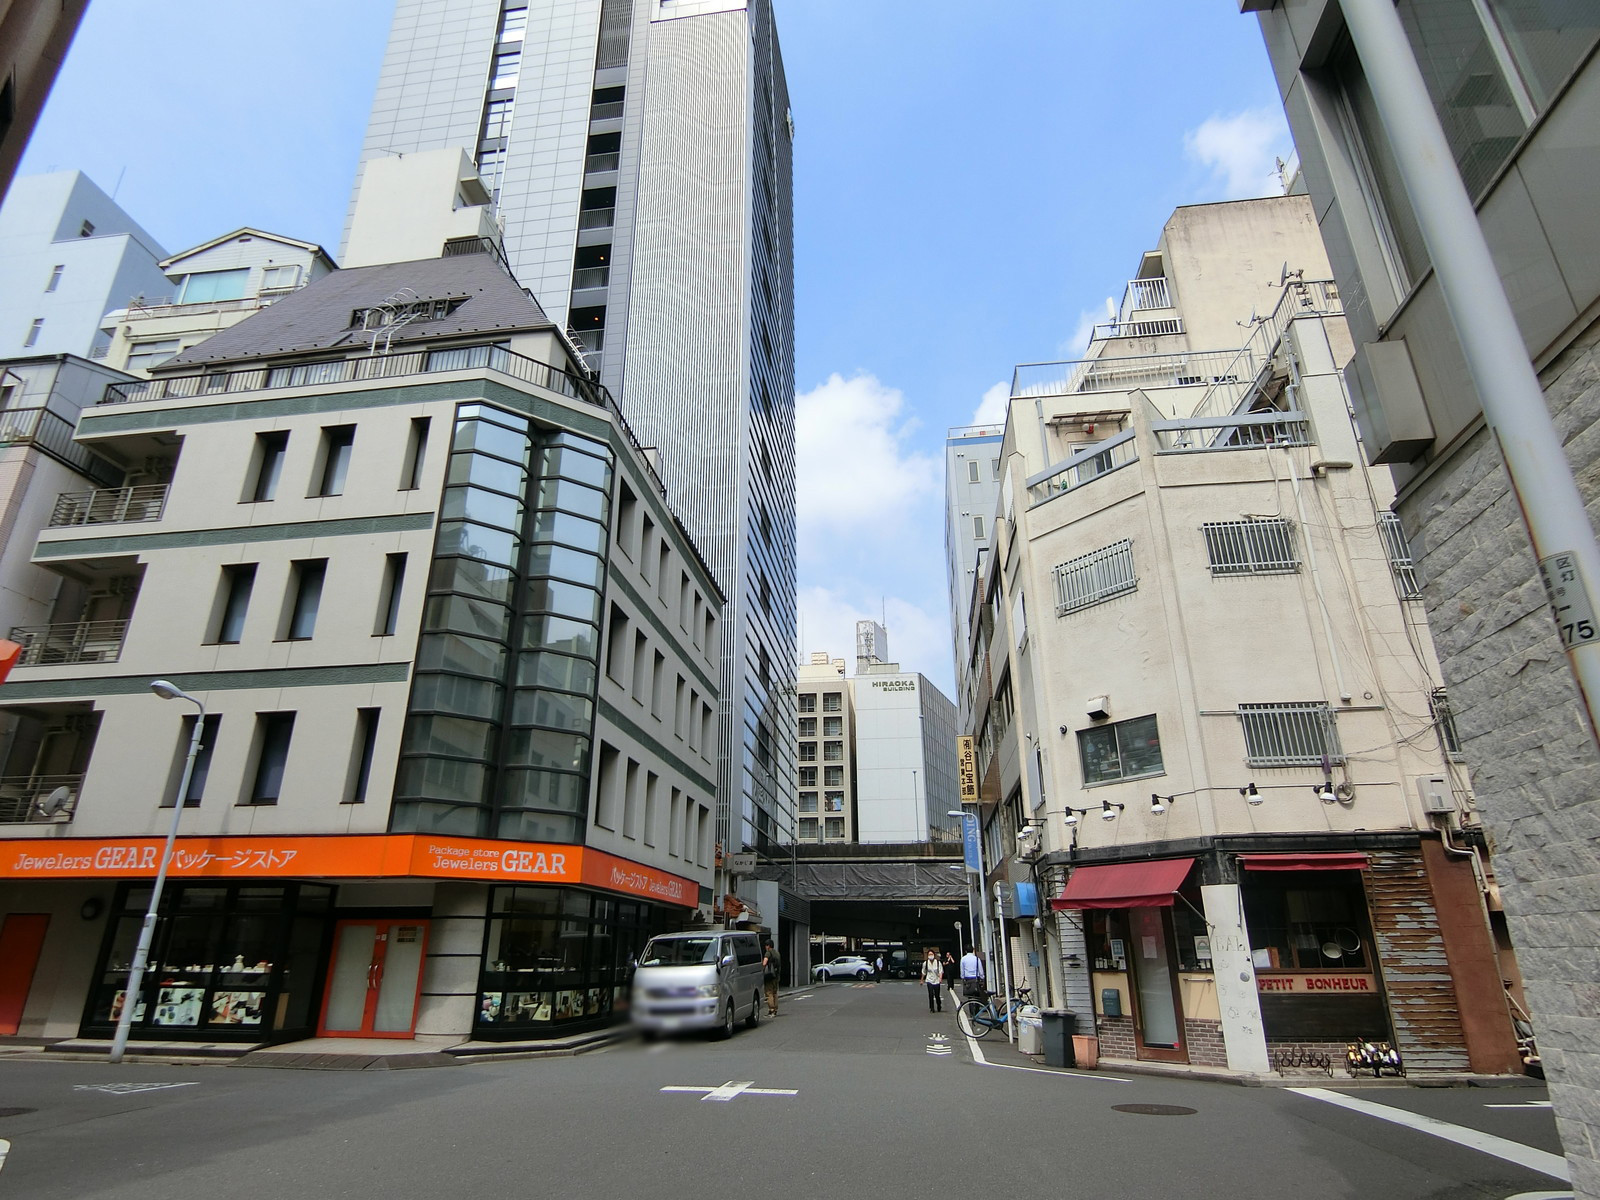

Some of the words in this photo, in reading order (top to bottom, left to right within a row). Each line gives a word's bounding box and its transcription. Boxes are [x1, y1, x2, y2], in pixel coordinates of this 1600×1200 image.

[872, 680, 915, 688] HIRAOKA
[13, 853, 93, 870] Jewelers
[95, 846, 158, 869] GEAR
[168, 849, 298, 870] パッケージストア
[428, 844, 470, 857] Package
[473, 848, 500, 858] store
[433, 855, 499, 872] Jewelers
[501, 849, 567, 875] GEAR
[610, 866, 649, 890] パッケージストア
[649, 879, 669, 896] Jewelers
[668, 880, 683, 899] GEAR
[1258, 978, 1294, 991] PETIT
[1305, 978, 1369, 991] BONHEUR
